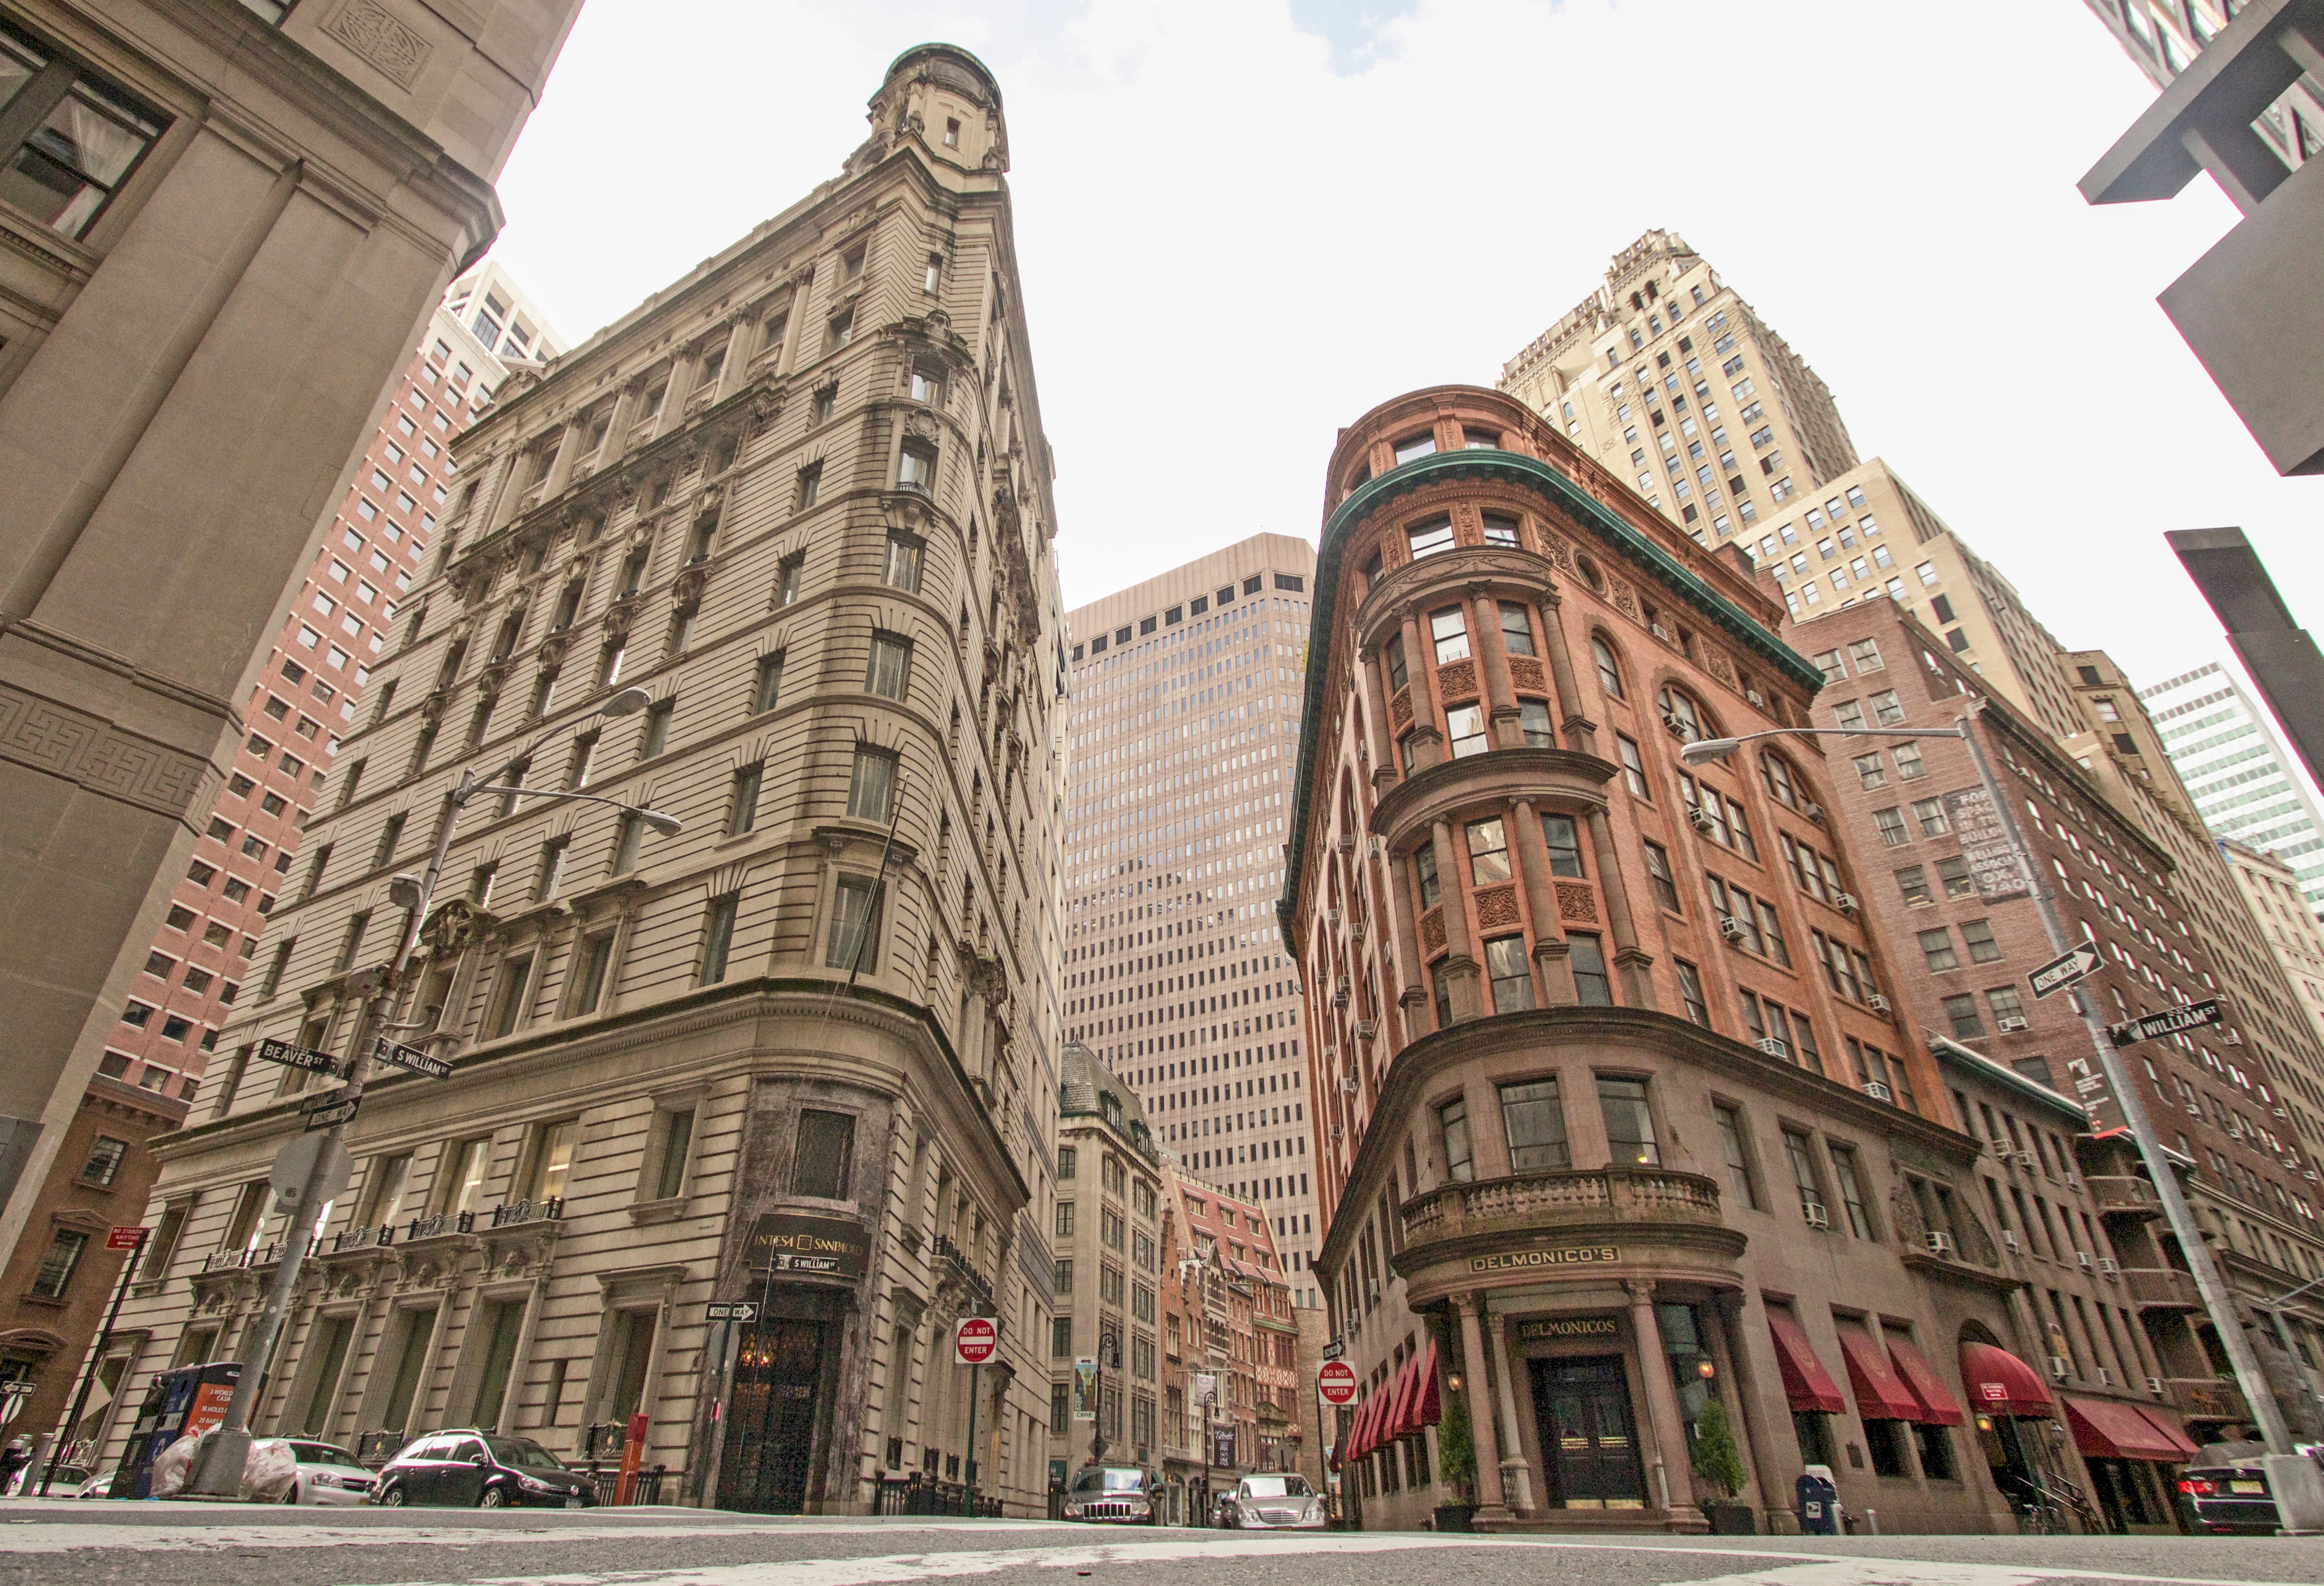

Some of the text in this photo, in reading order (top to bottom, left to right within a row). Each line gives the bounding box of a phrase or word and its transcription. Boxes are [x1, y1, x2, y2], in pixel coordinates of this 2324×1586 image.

[2036, 958, 2080, 990] ONE WAY
[2142, 1009, 2208, 1036] WILLIAM
[2204, 1005, 2216, 1015] ST
[264, 1044, 323, 1067] BEAVER ST
[397, 1049, 405, 1061] S
[404, 1051, 441, 1076] WILLIAM
[315, 1103, 352, 1122] ONE WAY
[755, 1234, 863, 1256] INTESA SANPAOLO
[794, 1259, 800, 1268] S
[800, 1259, 829, 1269] WILLIAM
[1473, 1248, 1615, 1271] DELMONICO'S
